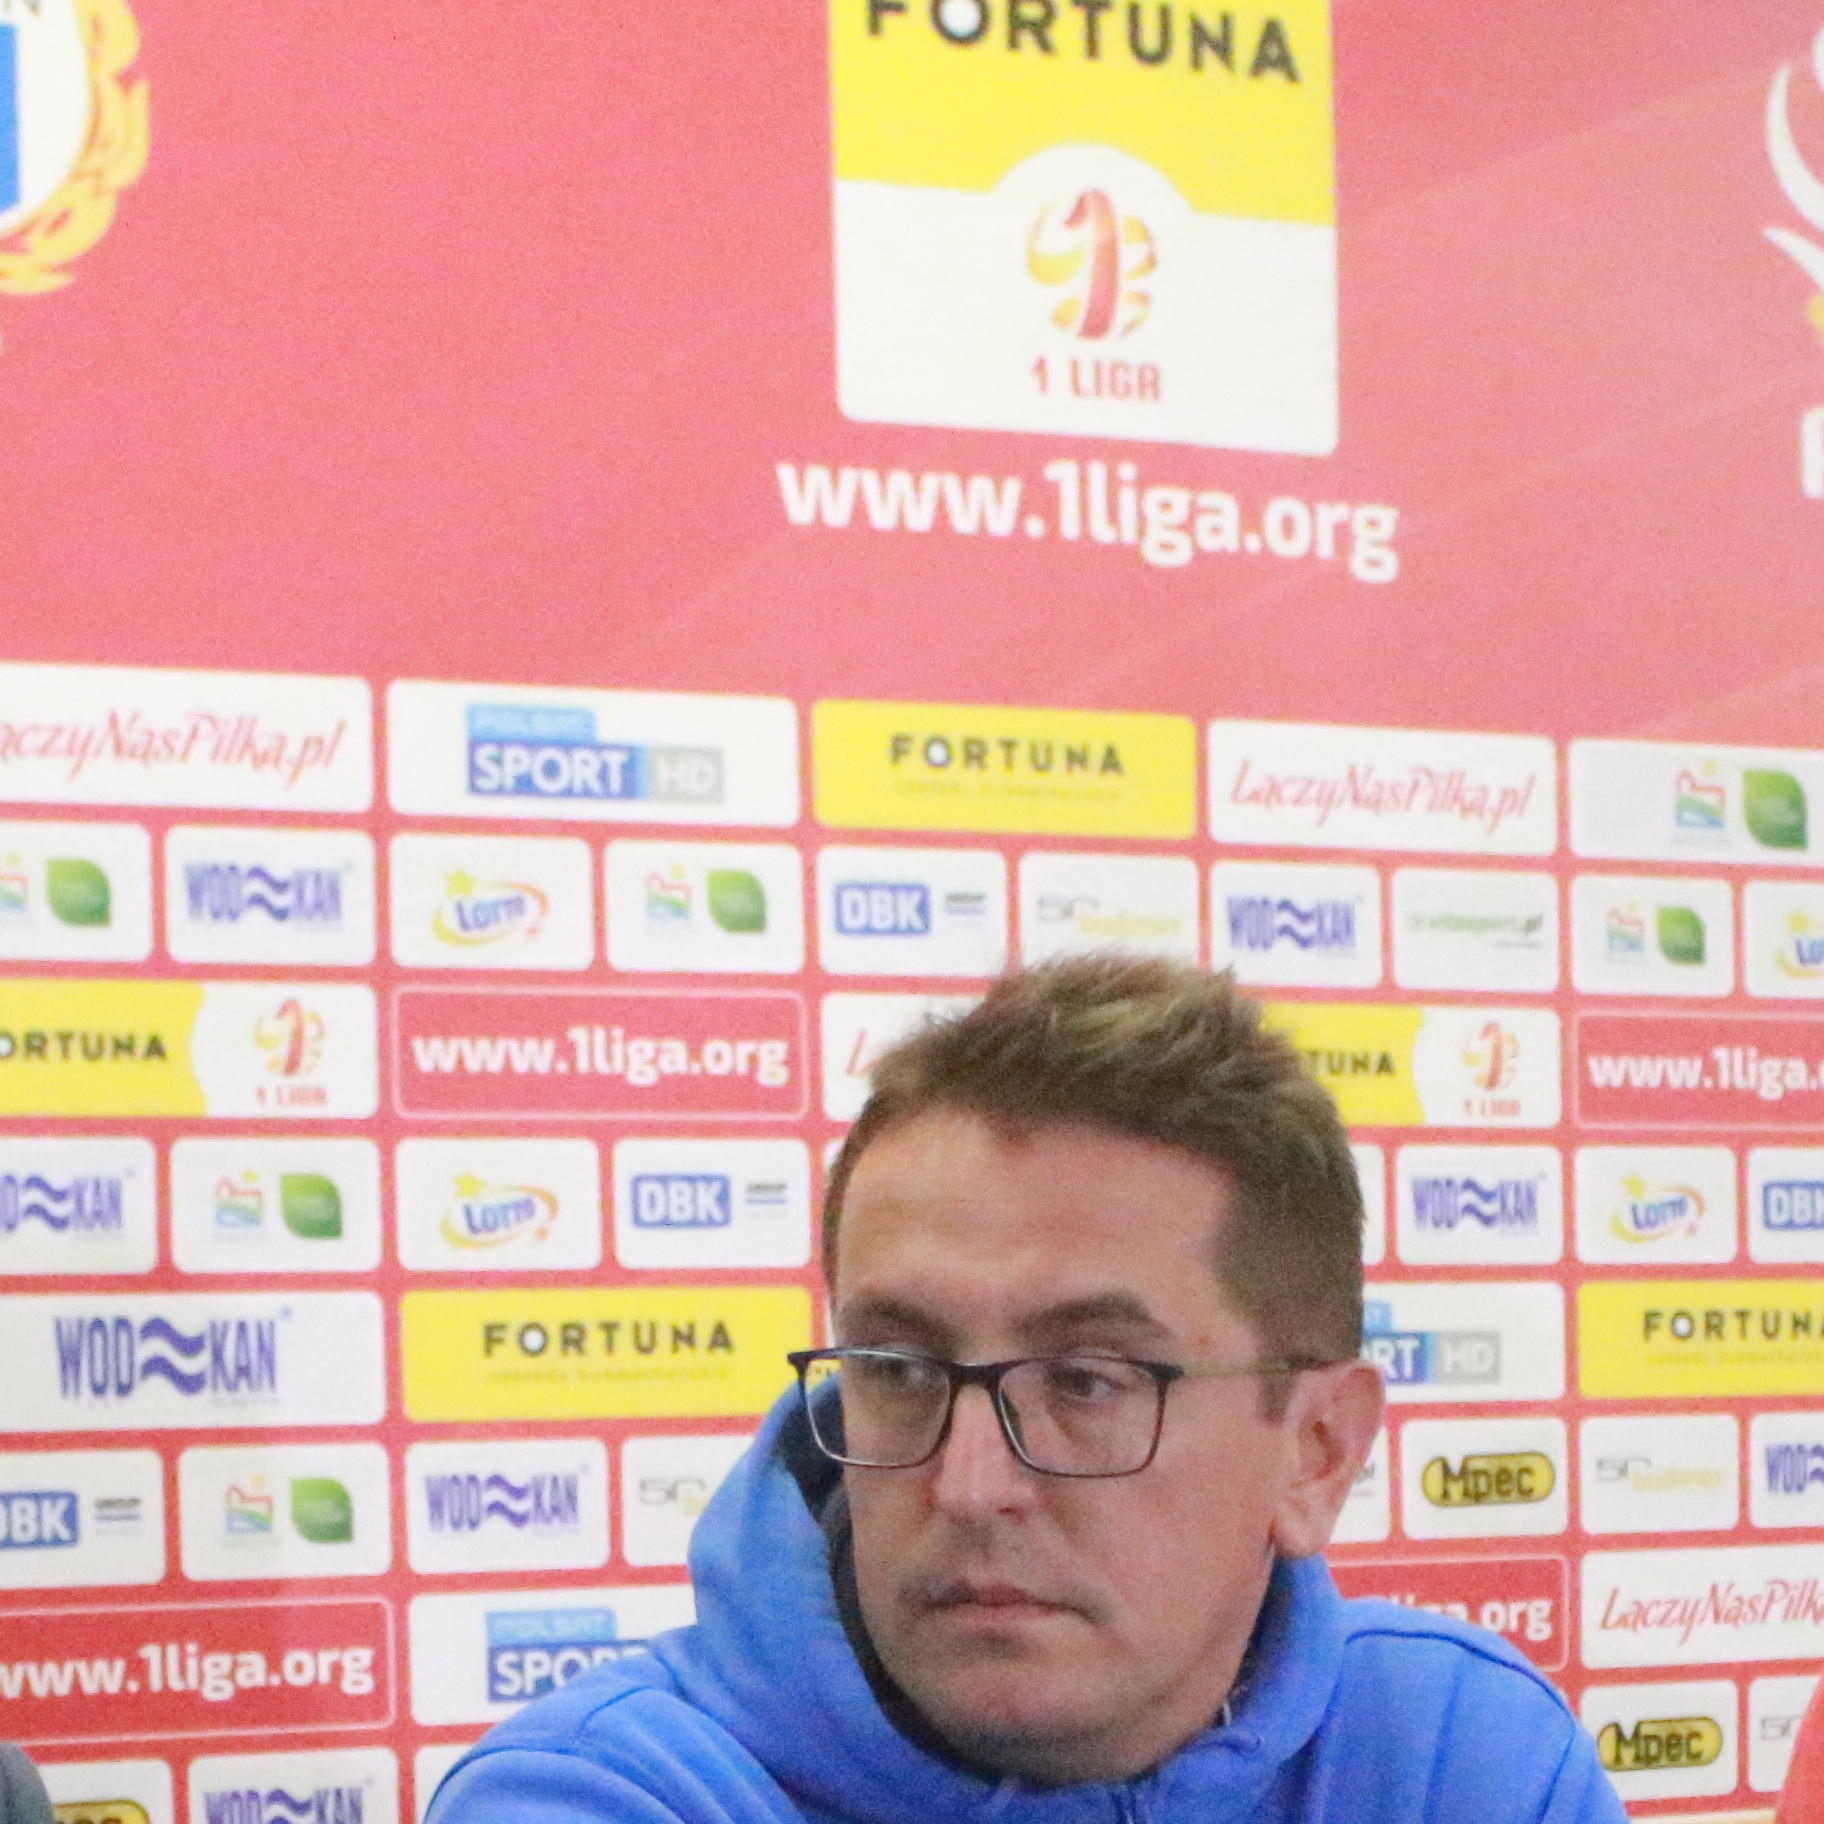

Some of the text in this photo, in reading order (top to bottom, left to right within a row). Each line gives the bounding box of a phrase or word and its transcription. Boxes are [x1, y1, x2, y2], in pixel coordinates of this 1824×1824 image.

[864, 0, 1301, 84] FORTUNA
[1030, 355, 1163, 404] 1 LIGA
[776, 457, 1400, 585] www.1liga.org
[469, 748, 719, 798] SPORT HD
[890, 732, 1126, 778] FORTUNA
[839, 886, 926, 930] DBK
[411, 1025, 790, 1089] www.1liga.org
[1298, 1047, 1397, 1078] TUNA
[637, 1179, 725, 1224] DBK
[482, 1320, 736, 1358] FORTUNA
[1444, 1340, 1495, 1374] HD
